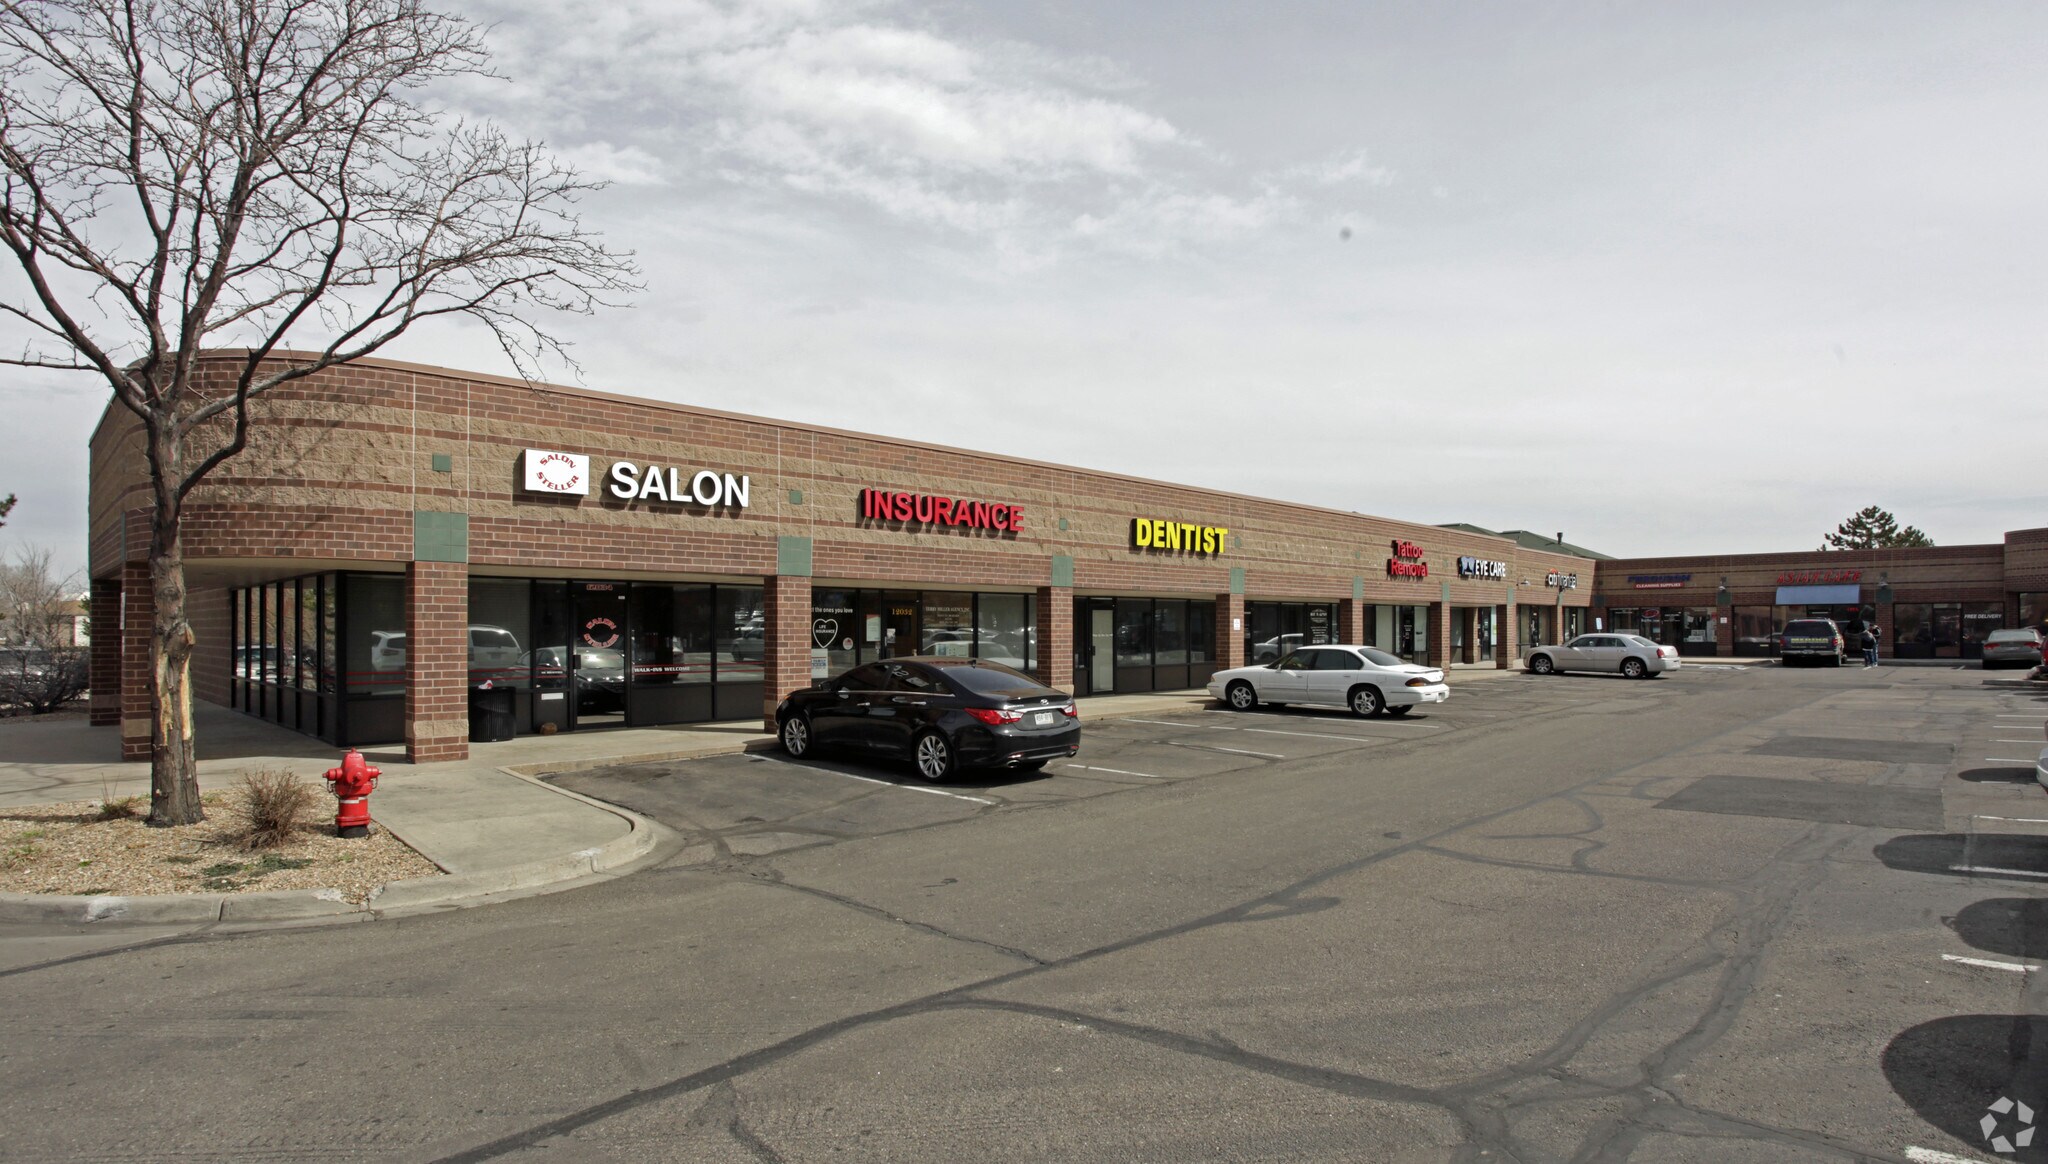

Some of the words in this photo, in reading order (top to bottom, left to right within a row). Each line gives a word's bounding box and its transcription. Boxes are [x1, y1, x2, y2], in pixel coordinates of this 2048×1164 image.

[540, 453, 577, 469] SALON
[536, 471, 580, 491] STELLER
[610, 461, 749, 508] SALON
[863, 488, 1025, 532] INSURANCE
[1136, 518, 1229, 554] DENTIST
[1396, 539, 1424, 559] Tattoo
[1391, 558, 1428, 577] Removal
[1475, 559, 1489, 576] EYE
[1490, 561, 1506, 578] CARE
[1776, 570, 1821, 585] ASIAN
[1824, 568, 1862, 583] CAFE
